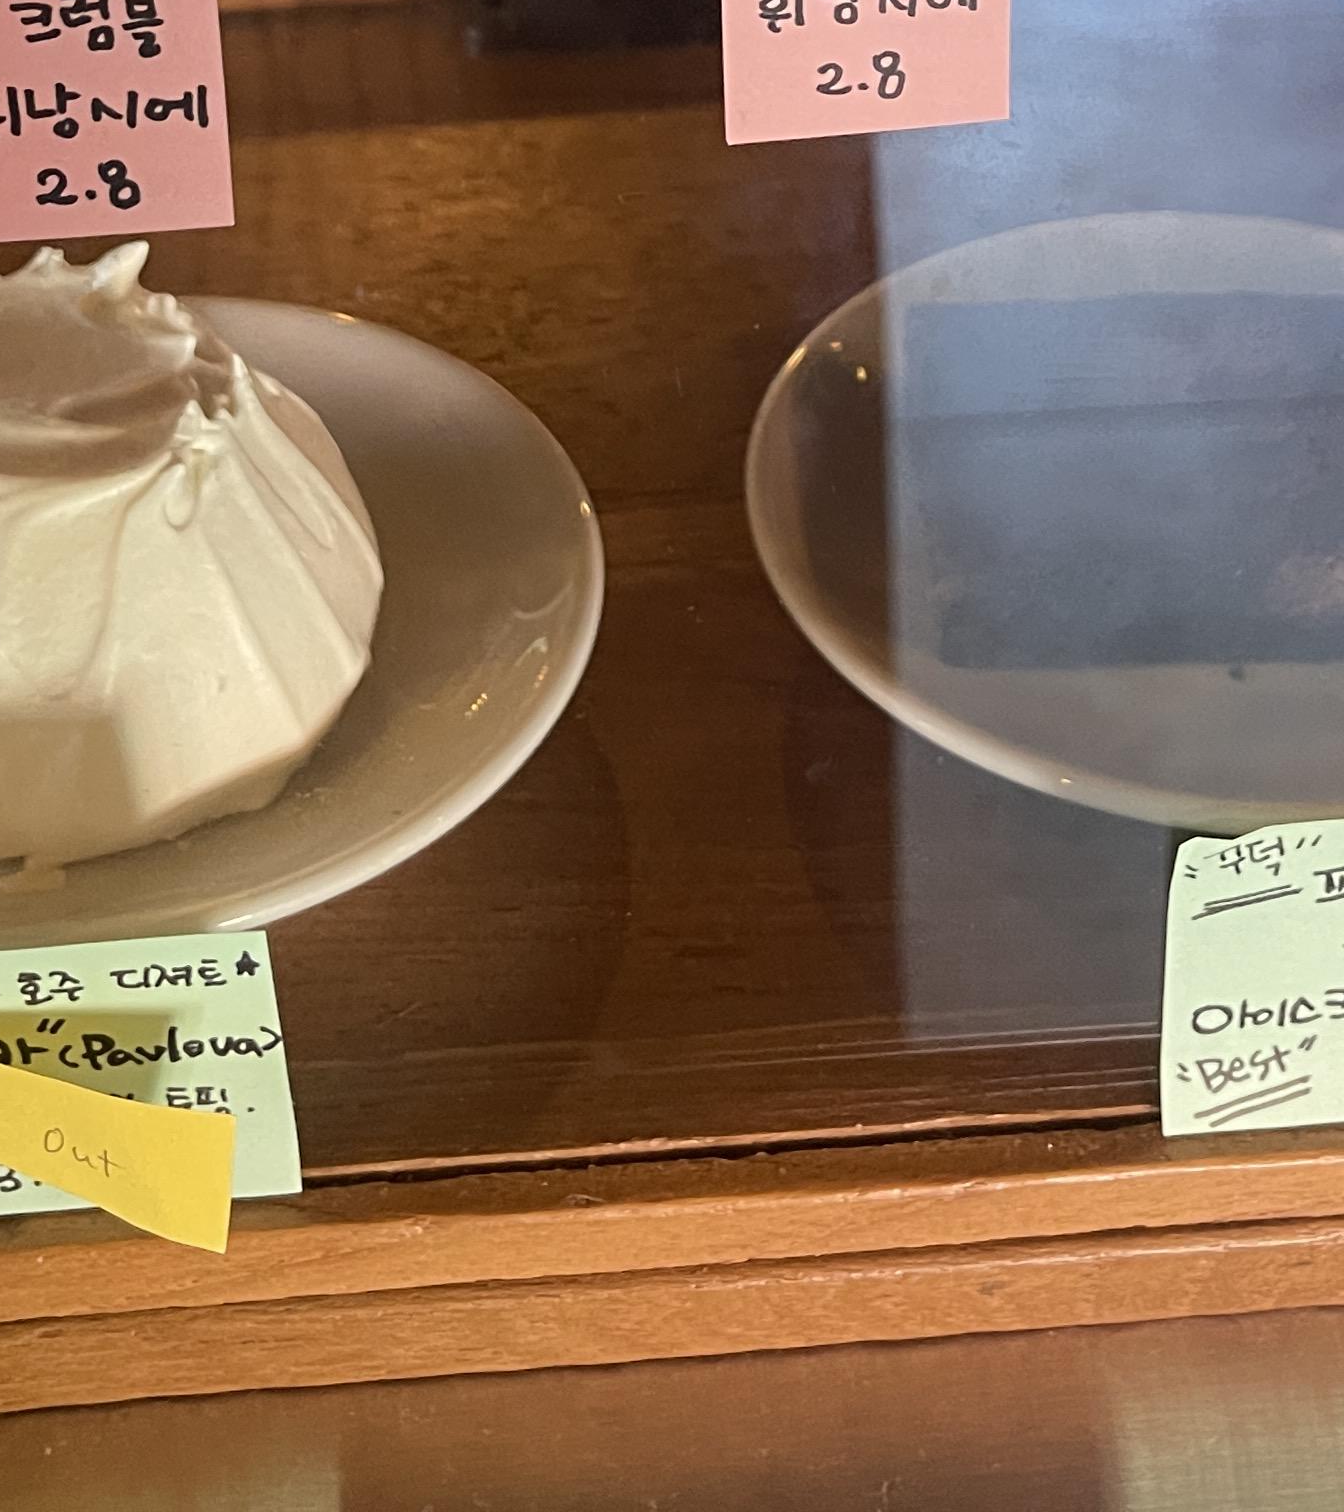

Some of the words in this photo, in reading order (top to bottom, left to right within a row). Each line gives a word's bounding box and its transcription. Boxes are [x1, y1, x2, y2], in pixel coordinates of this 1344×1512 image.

[816, 50, 906, 99] 2.8
[36, 159, 141, 210] 2.8
[17, 970, 84, 1005] 호주
[44, 1127, 125, 1178] Out
